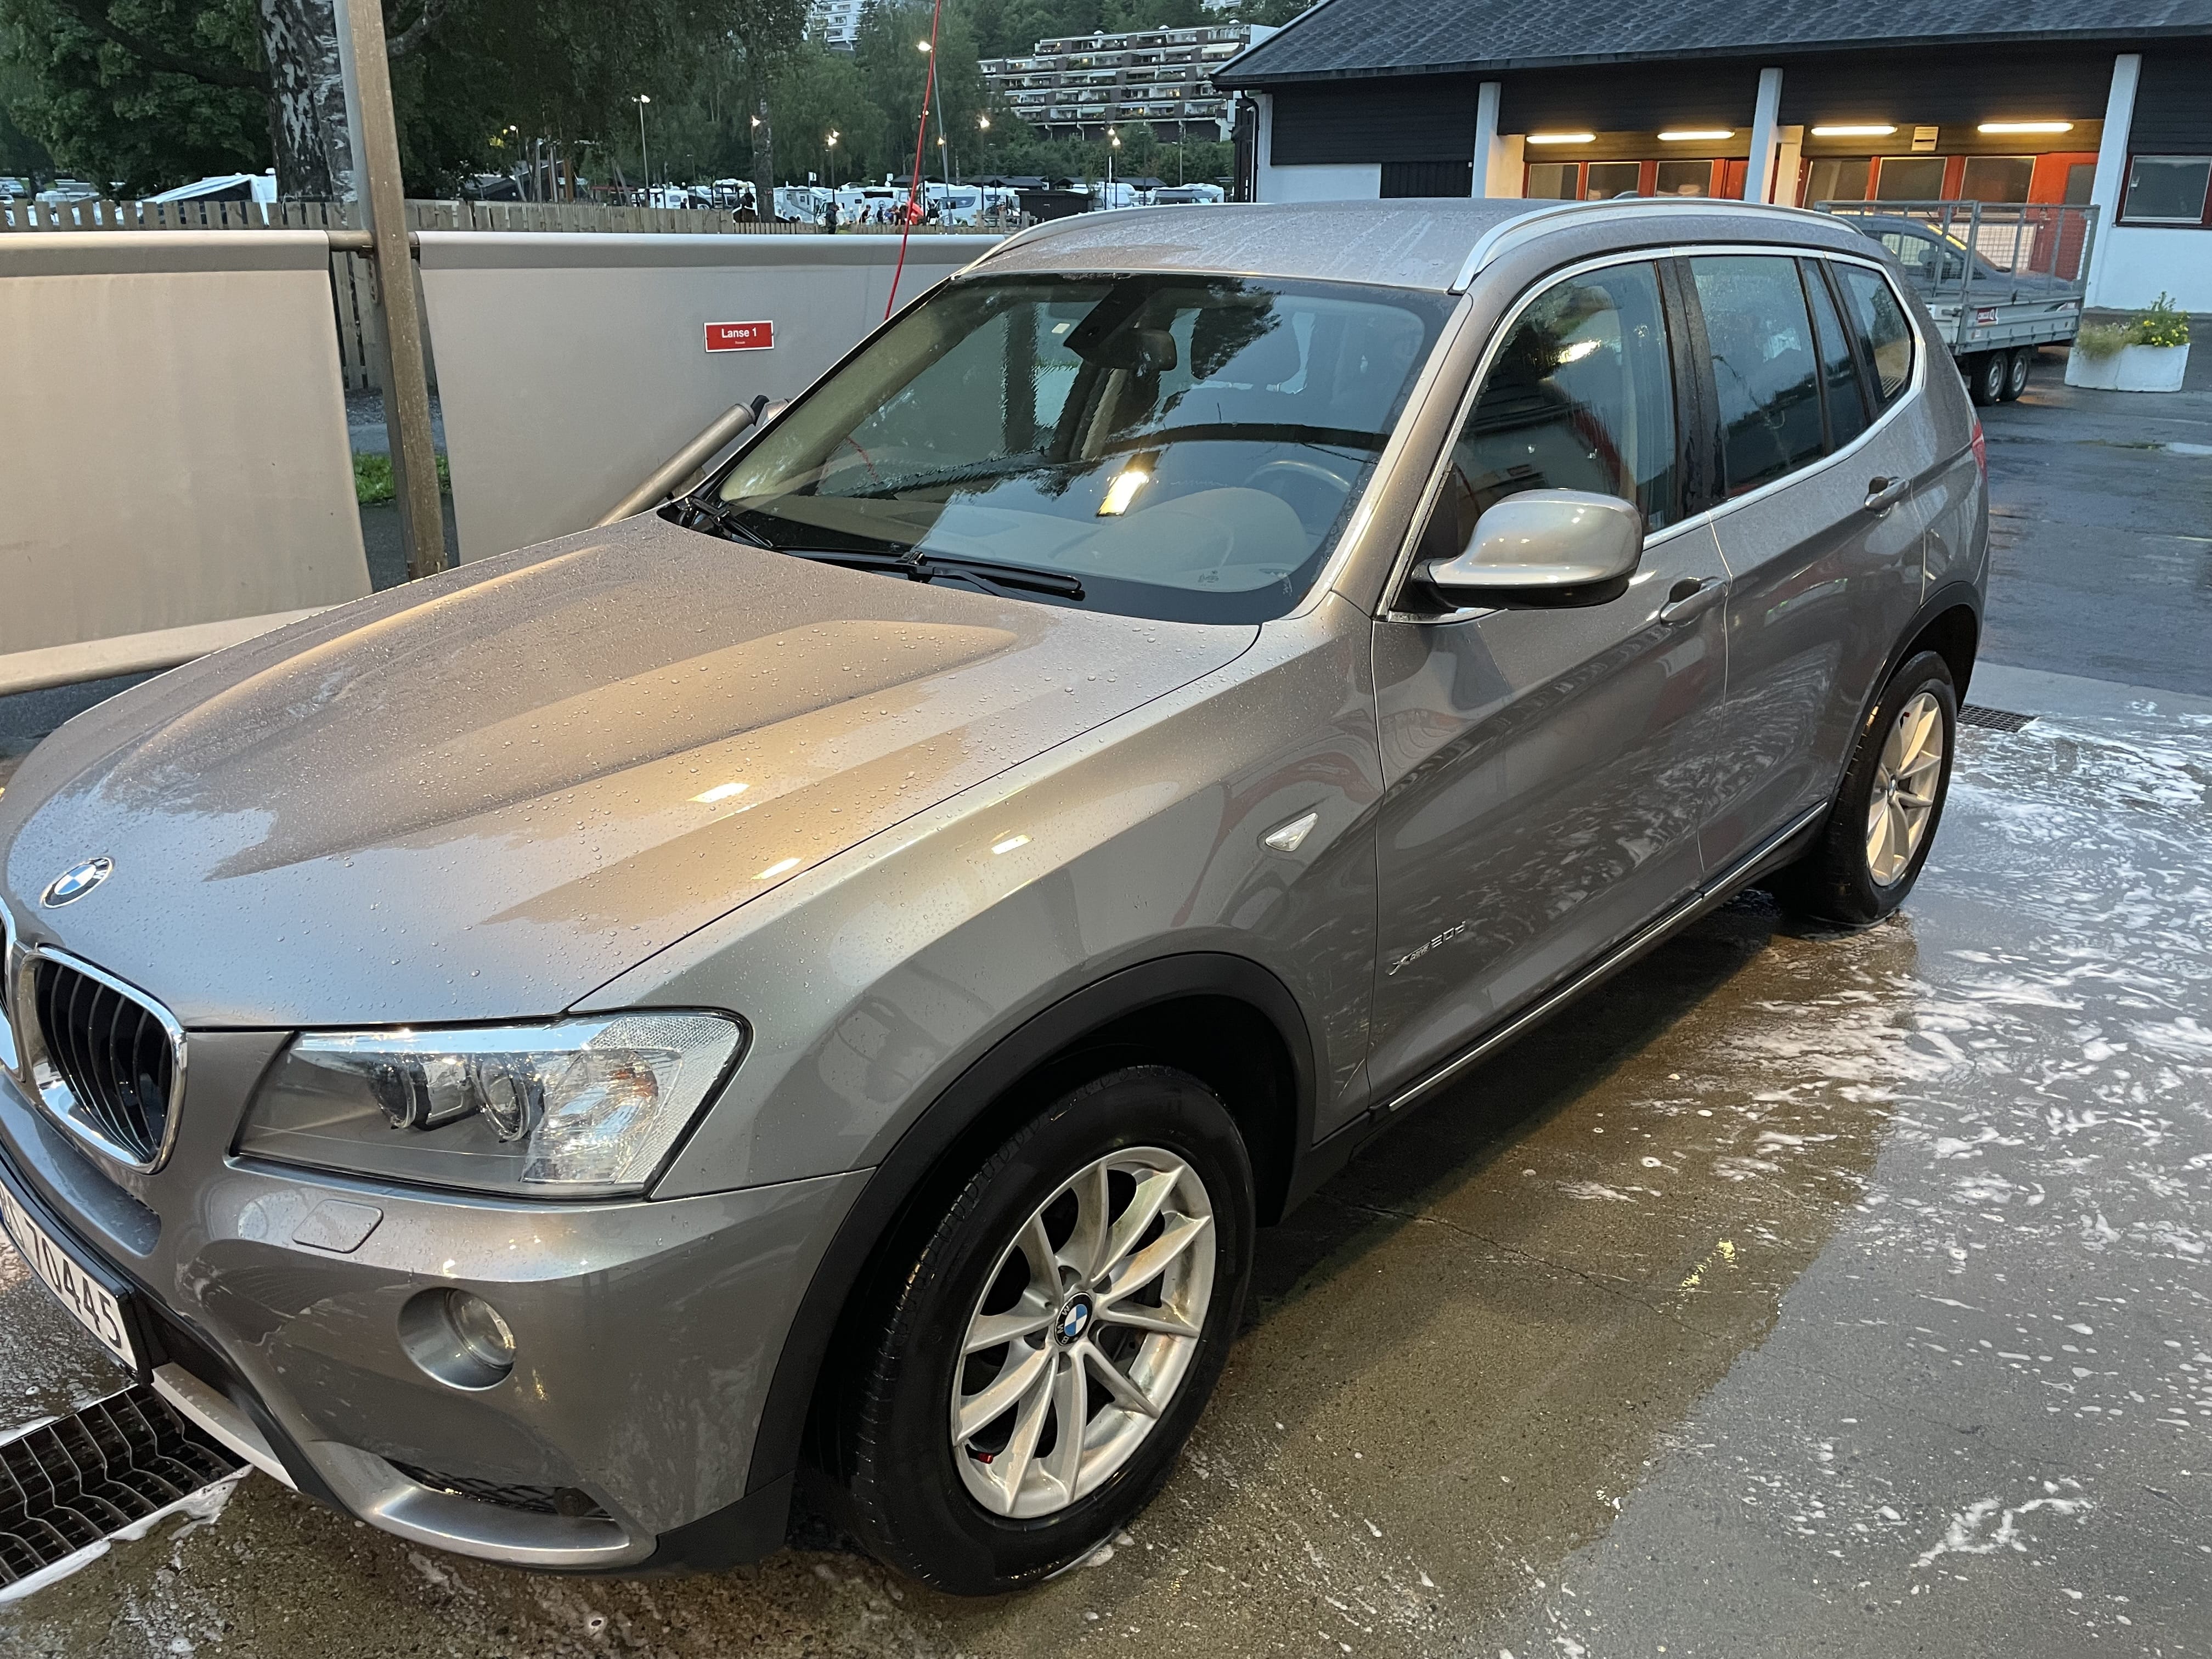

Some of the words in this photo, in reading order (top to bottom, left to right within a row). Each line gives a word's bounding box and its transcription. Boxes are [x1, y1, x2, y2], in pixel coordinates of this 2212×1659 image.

[721, 328, 749, 338] Lanse
[752, 328, 757, 337] 1
[24, 1216, 122, 1348] 70445
[1057, 1305, 1071, 1344] BMW
